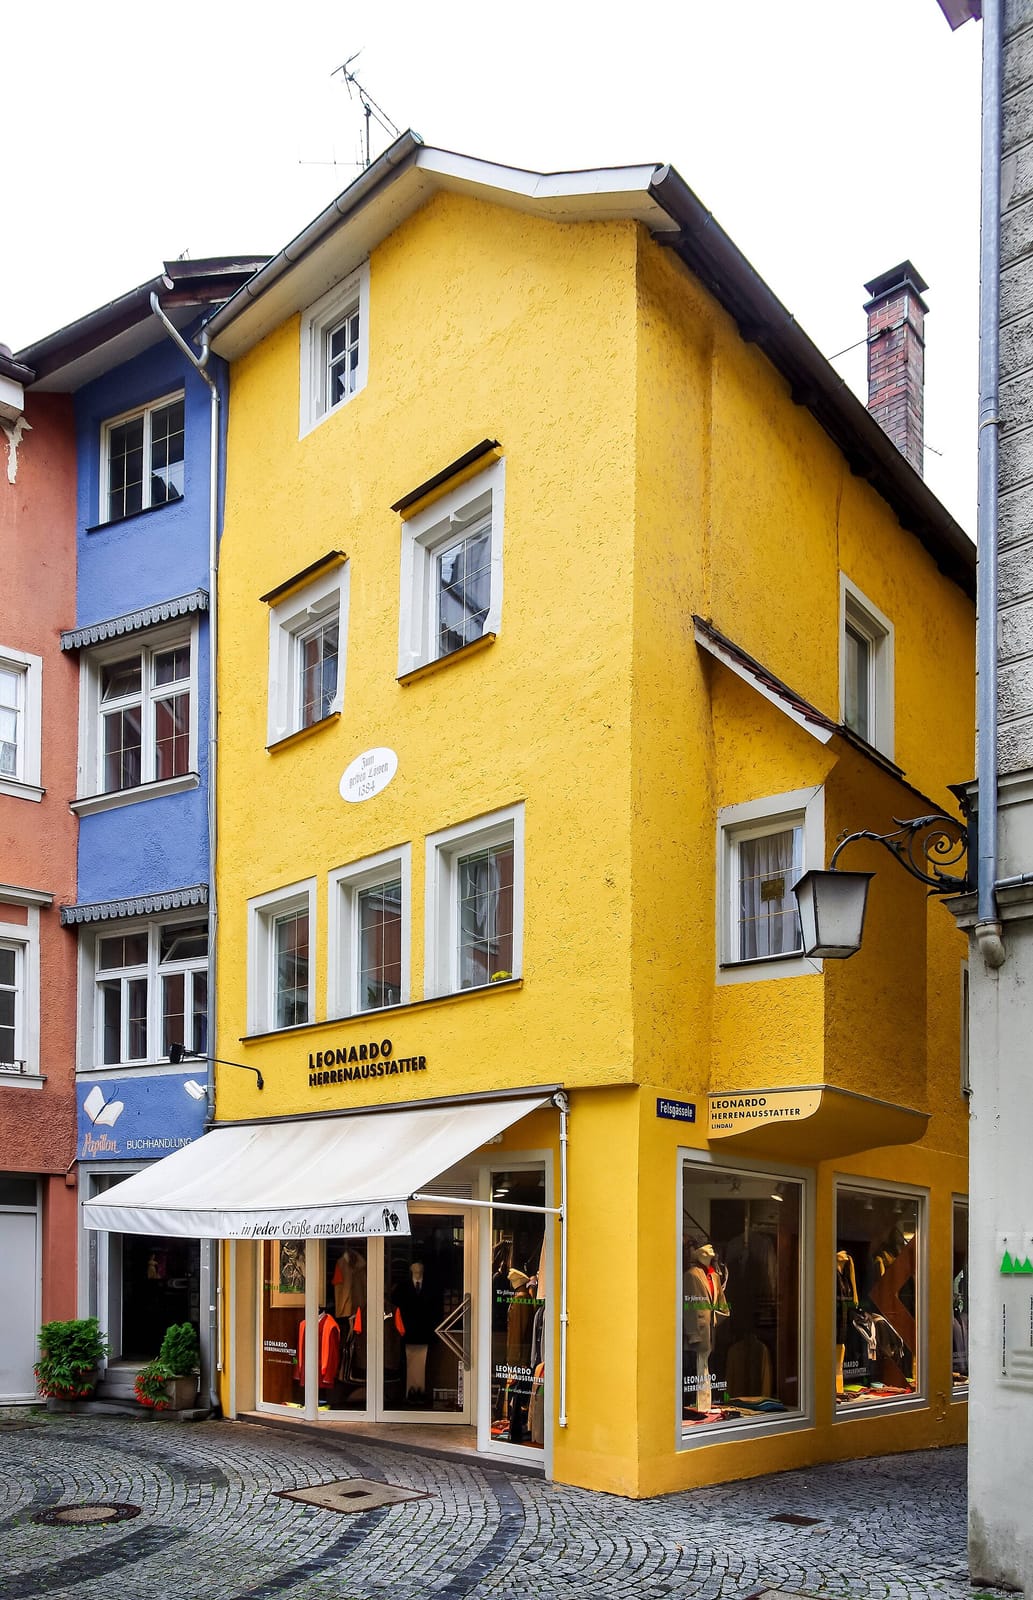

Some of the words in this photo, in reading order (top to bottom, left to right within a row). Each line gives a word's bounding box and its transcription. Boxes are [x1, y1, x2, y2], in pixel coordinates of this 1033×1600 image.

[308, 1038, 393, 1069] LEONARDO
[308, 1056, 427, 1087] HERRENAUSSTATTER
[711, 1097, 767, 1110] LEONARDO
[711, 1108, 801, 1120] HERRENAUSSTATTER
[81, 1132, 122, 1157] Papillon
[126, 1137, 193, 1150] BUCHHANDLUNG
[251, 1220, 280, 1238] jeder
[282, 1219, 312, 1237] Größe
[313, 1216, 366, 1235] anziehend
[495, 1364, 532, 1375] LEONARDO
